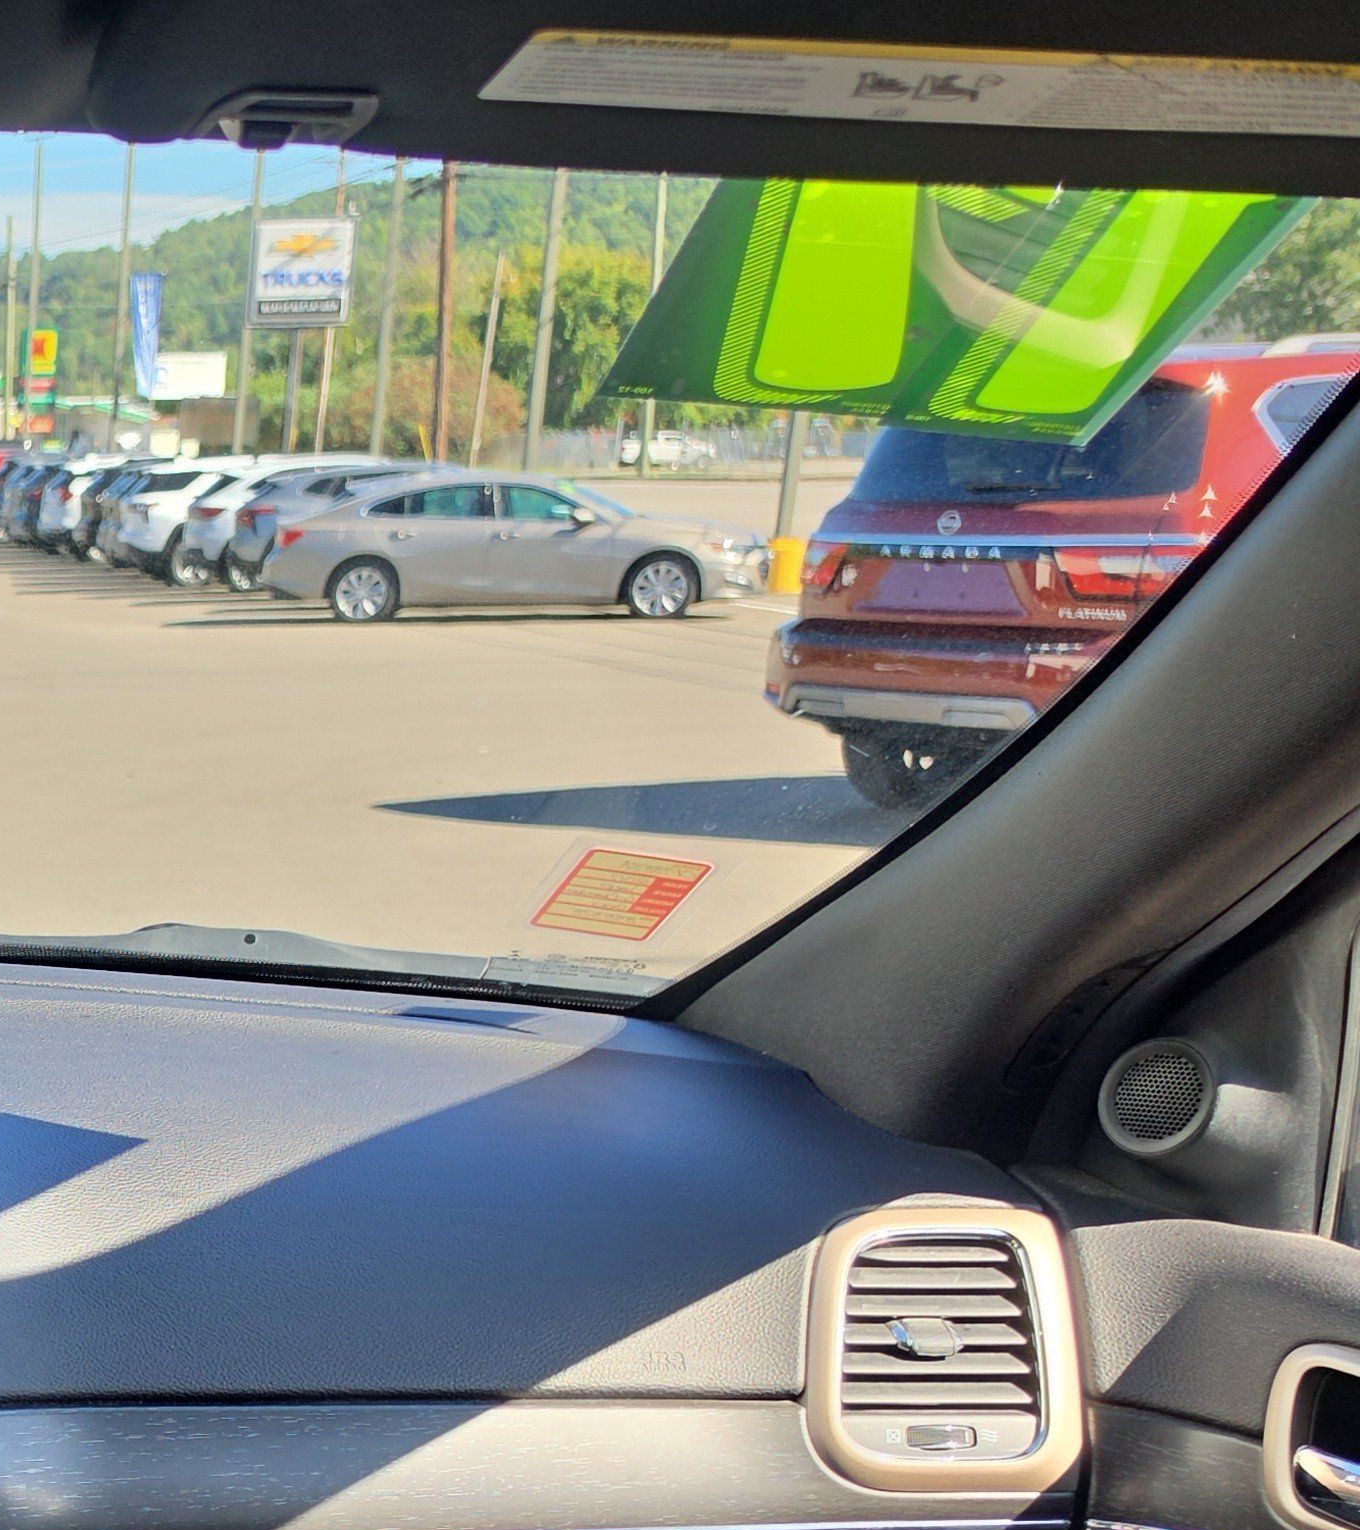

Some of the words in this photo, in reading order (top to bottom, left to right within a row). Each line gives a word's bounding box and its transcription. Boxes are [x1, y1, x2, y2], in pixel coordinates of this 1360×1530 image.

[262, 268, 344, 288] TRUCKS
[880, 544, 1002, 560] ARMADA
[1057, 606, 1128, 622] PLATINUM
